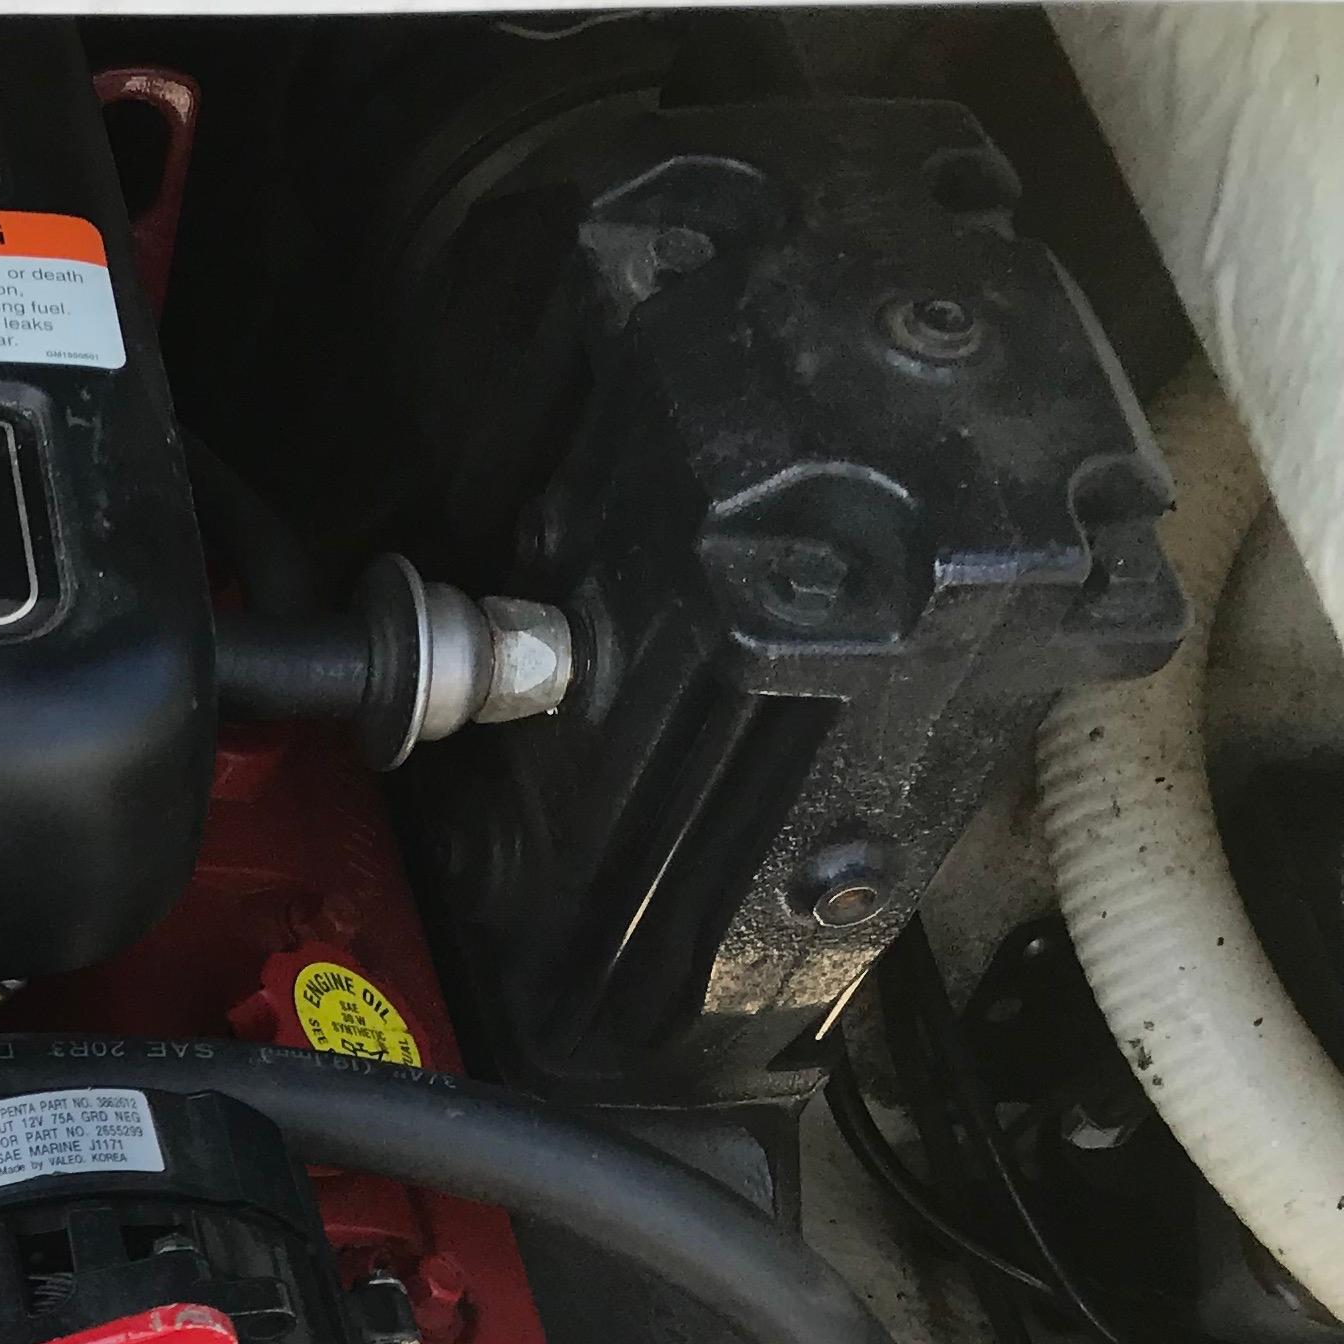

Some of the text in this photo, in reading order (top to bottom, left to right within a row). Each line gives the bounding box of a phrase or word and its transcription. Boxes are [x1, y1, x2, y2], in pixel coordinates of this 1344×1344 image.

[7, 269, 26, 280] or
[31, 267, 84, 284] death
[31, 301, 71, 315] fuel.
[4, 316, 54, 331] leaks
[303, 971, 390, 1021] ENGINE OIL
[308, 1018, 328, 1045] SEE
[49, 1039, 126, 1059] 20R3
[144, 1039, 216, 1059] SAE
[398, 1036, 414, 1066] UAL
[0, 1103, 36, 1120] PENTA
[40, 1098, 68, 1111] PART
[72, 1096, 93, 1109] NO.
[22, 1116, 44, 1129] 12V
[51, 1113, 75, 1126] 75A
[81, 1110, 108, 1123] GRD
[115, 1111, 141, 1123] NEG
[26, 1128, 58, 1143] PART
[66, 1126, 88, 1139] NO.
[29, 1140, 82, 1157] MARINE
[89, 1138, 124, 1151] J1171
[31, 1160, 44, 1171] by
[91, 1152, 128, 1163] KOREA
